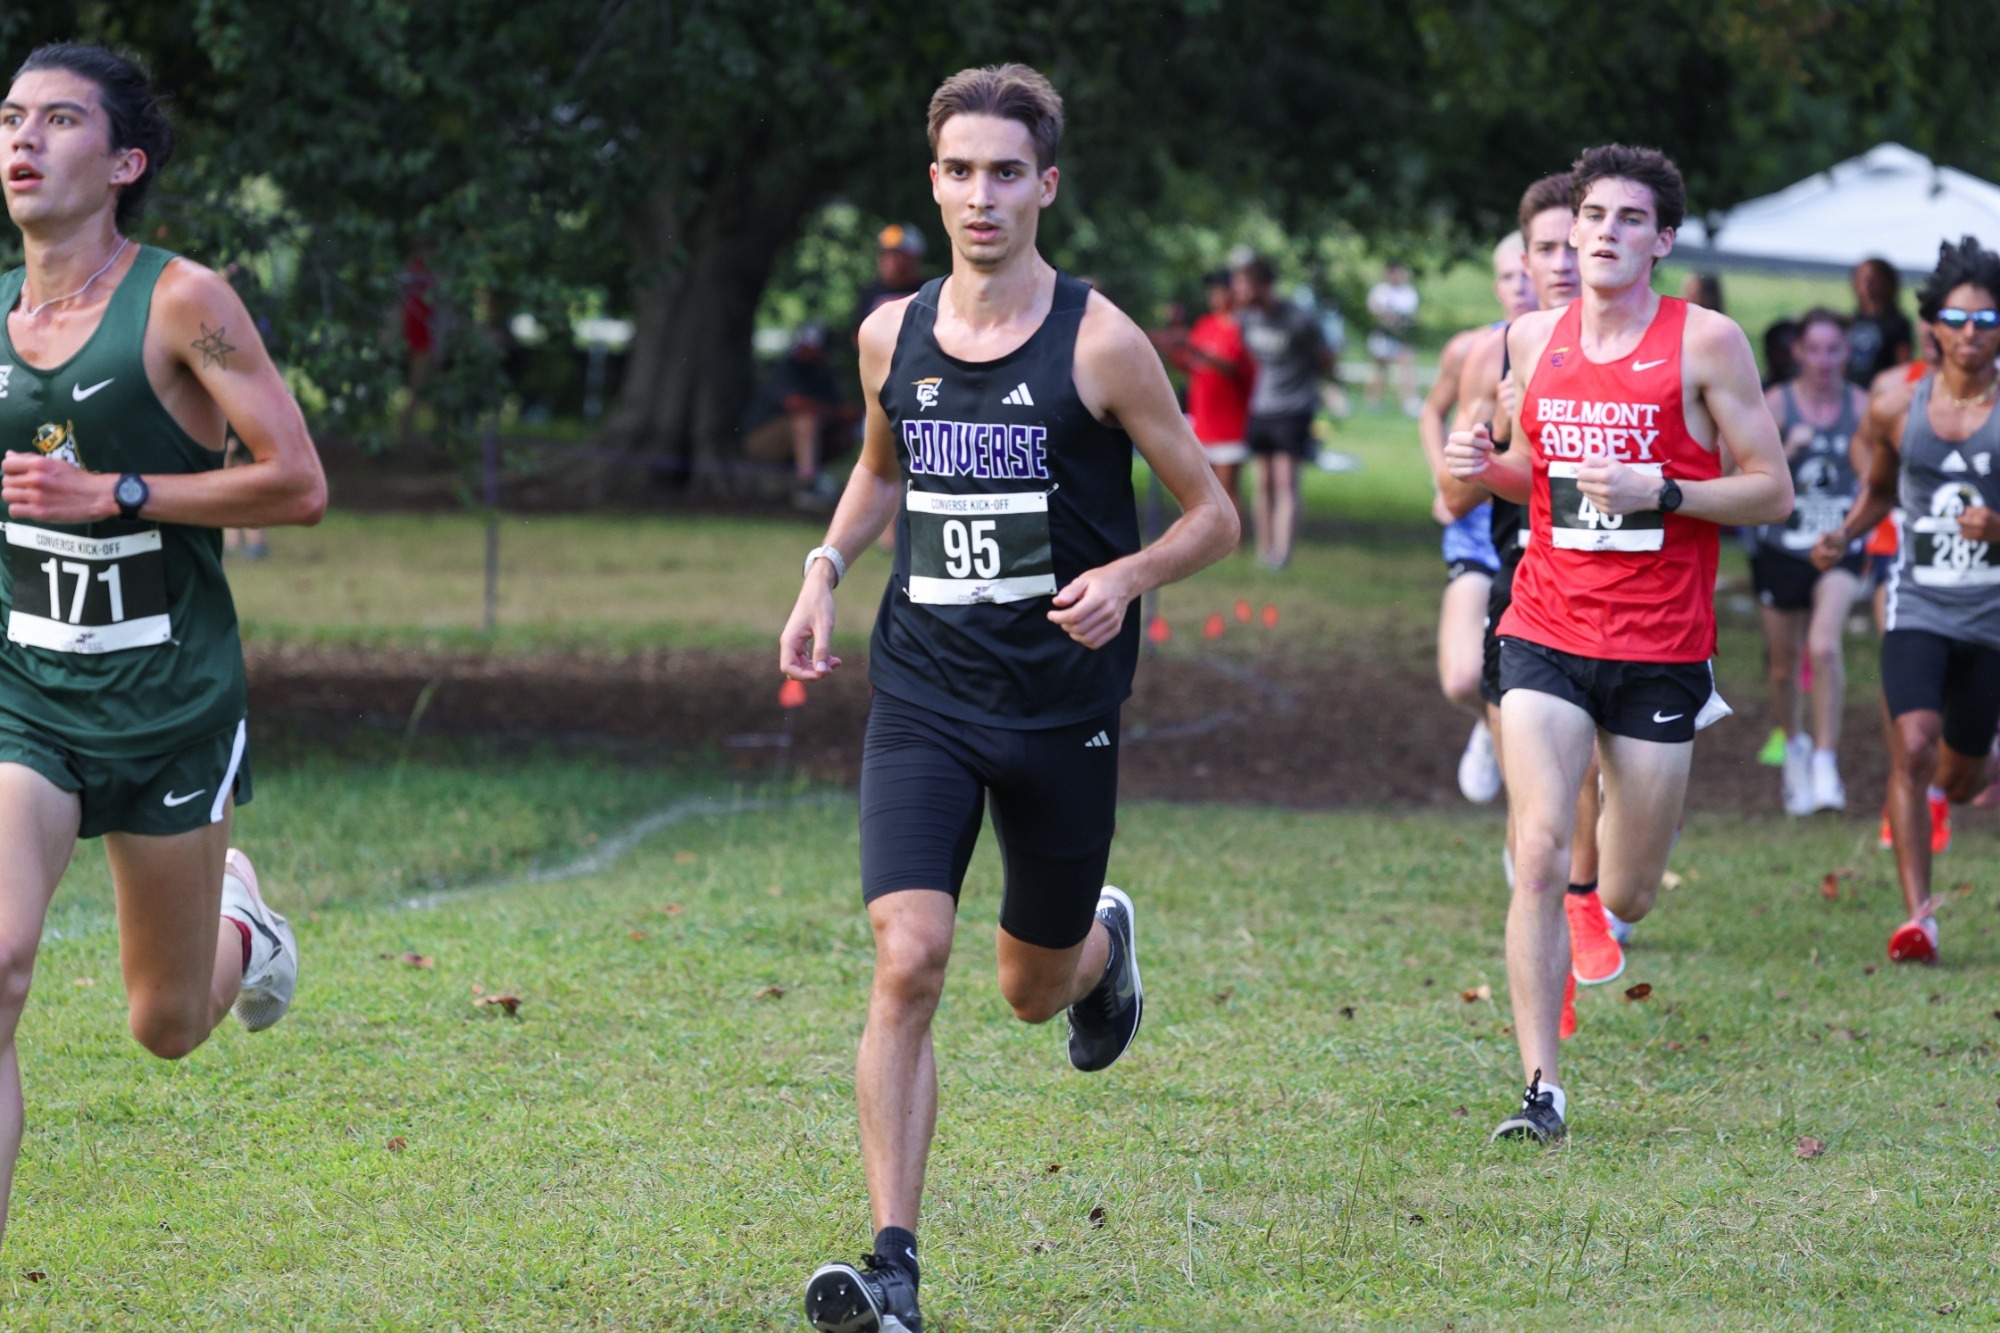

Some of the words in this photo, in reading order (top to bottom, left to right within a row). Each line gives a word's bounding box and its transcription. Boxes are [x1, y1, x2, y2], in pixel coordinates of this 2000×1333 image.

[1537, 398, 1660, 427] BELMONT
[902, 419, 1050, 480] CONVERSE
[1540, 422, 1660, 460] ABBEY
[931, 498, 967, 511] CONVERSE
[970, 498, 1009, 511] KICK-OFF
[36, 533, 75, 553] CONVERSE
[77, 541, 120, 556] KICK-OFF
[942, 519, 1001, 579] 95
[1931, 533, 1990, 568] 282
[40, 557, 124, 624] 171
